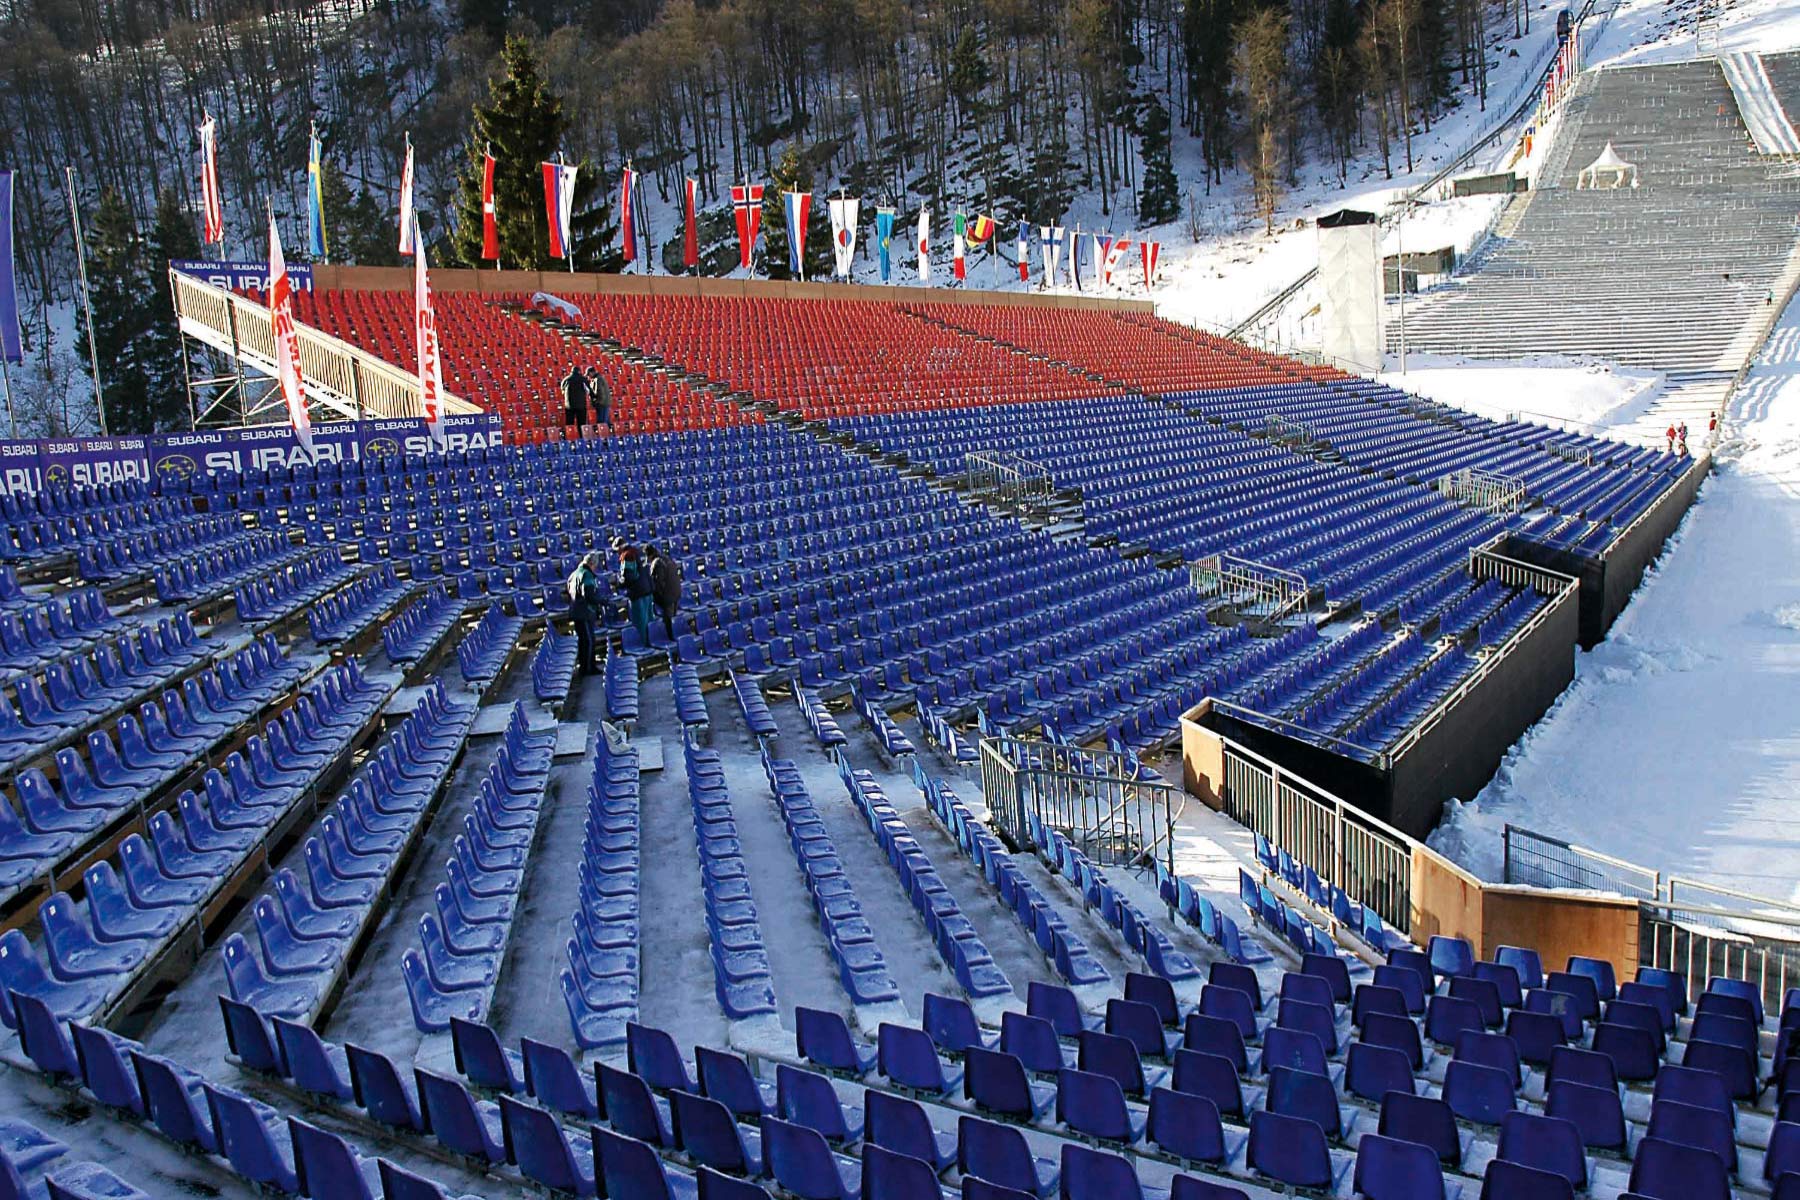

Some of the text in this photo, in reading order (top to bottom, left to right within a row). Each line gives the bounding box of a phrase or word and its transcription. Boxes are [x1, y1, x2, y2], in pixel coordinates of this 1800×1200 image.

[184, 262, 220, 270] SUBARU
[232, 263, 266, 271] SUBARU
[375, 420, 418, 431] SUBARU
[167, 433, 222, 447] SUBARU
[241, 429, 292, 441] SUBARU
[2, 444, 38, 456] SUBARU
[49, 439, 144, 454] SUBARU SUBARU SUBARU
[72, 458, 150, 491] SUBARU
